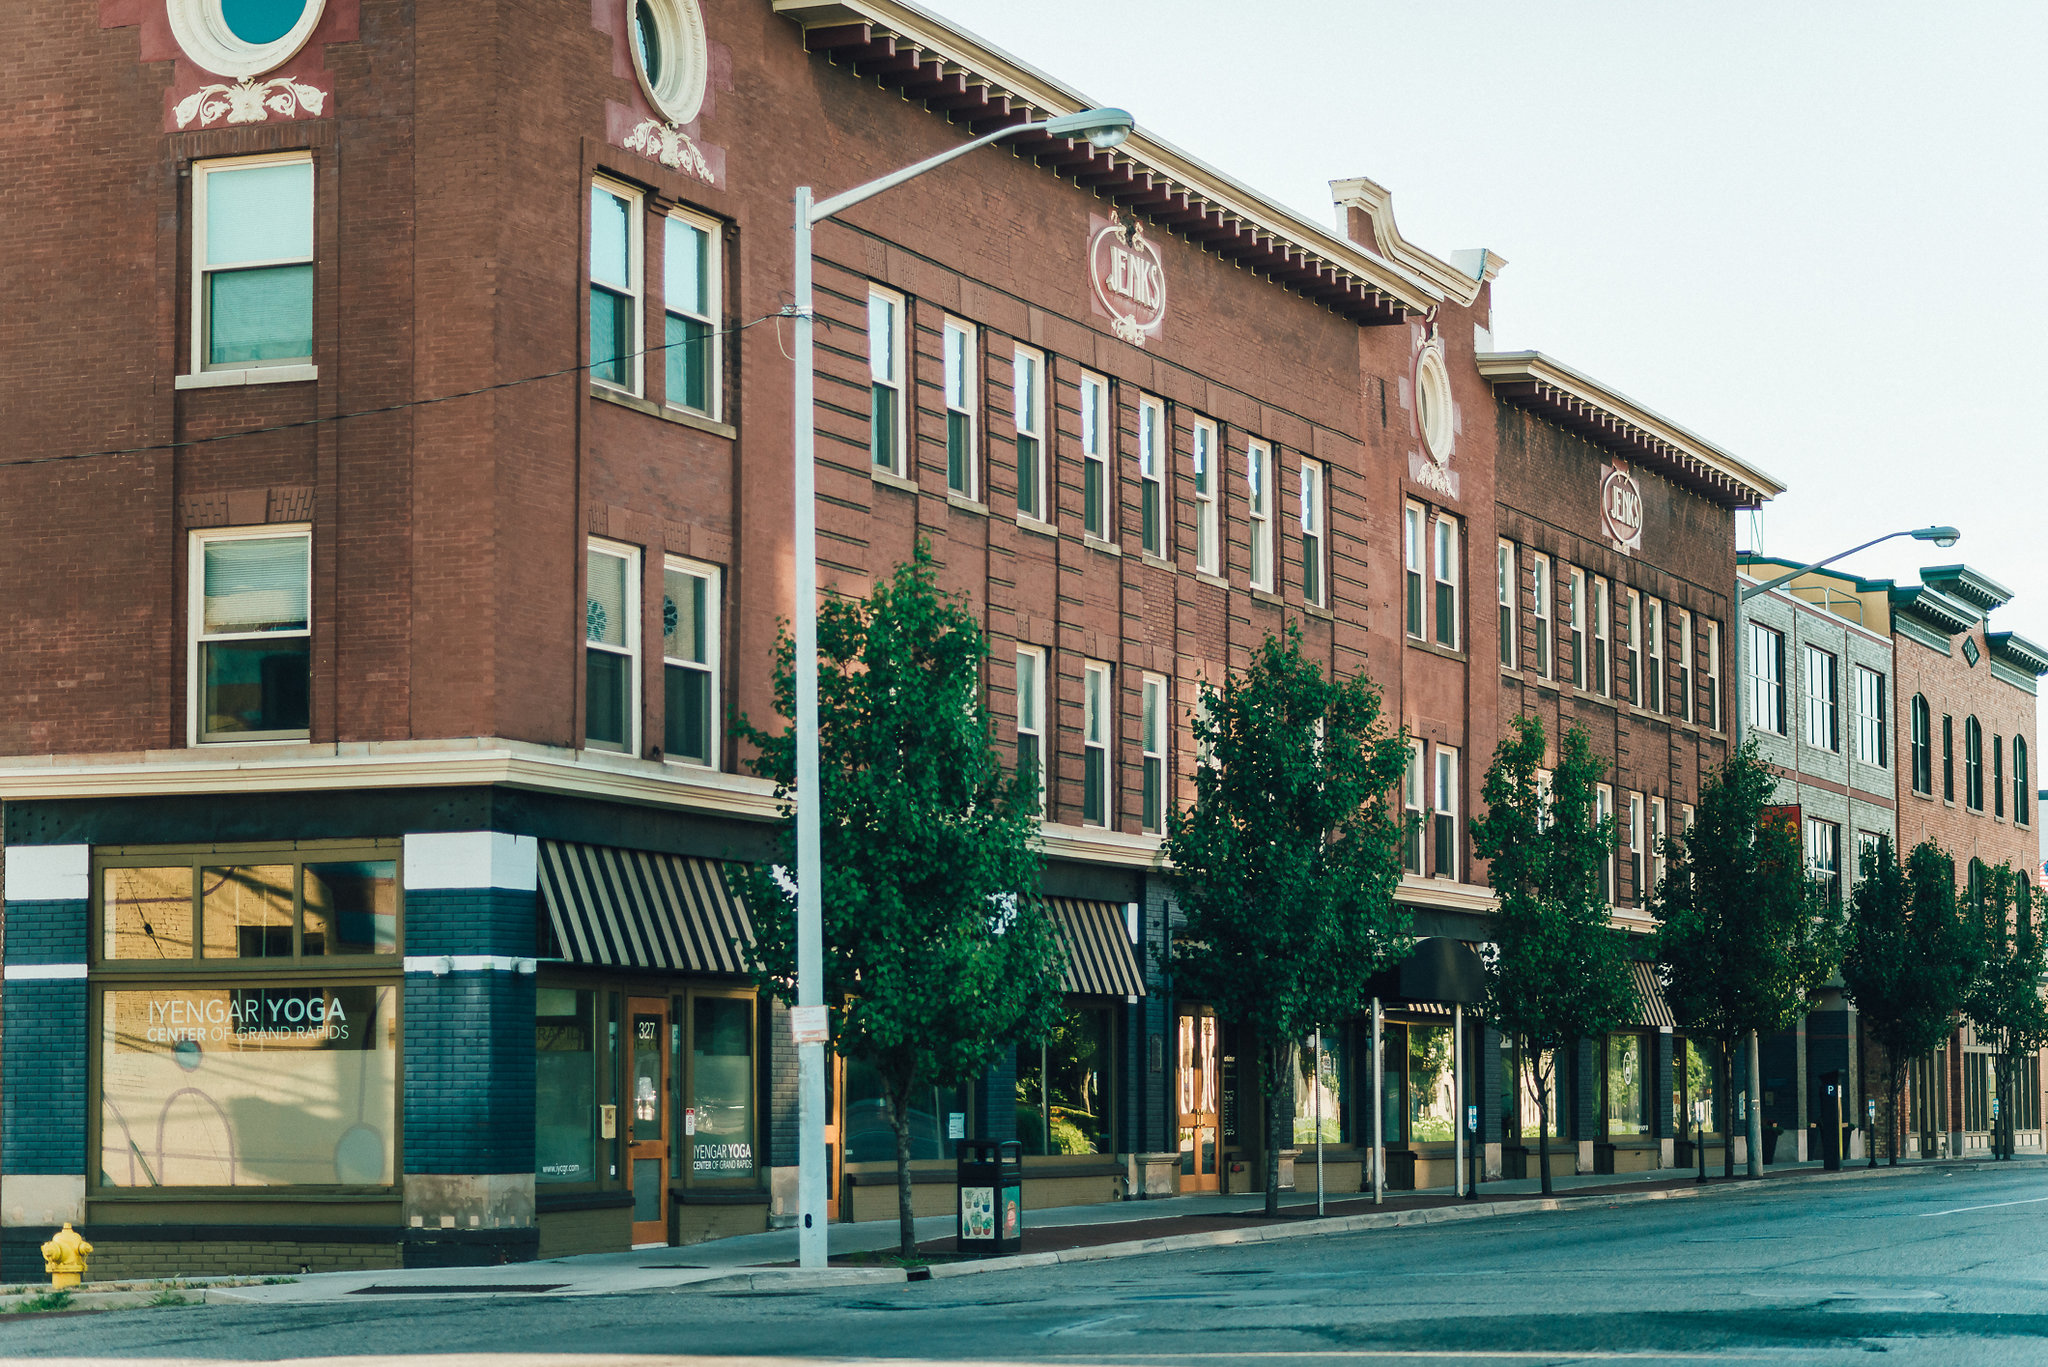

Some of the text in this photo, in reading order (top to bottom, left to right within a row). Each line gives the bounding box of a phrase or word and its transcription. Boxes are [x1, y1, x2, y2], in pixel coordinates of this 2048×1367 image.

[1106, 246, 1160, 309] JENKS
[1610, 485, 1640, 529] JENKS
[149, 997, 346, 1024] IYENGAR YOGA
[147, 1024, 349, 1043] CENTER OF GRAND RAPIDS
[638, 1021, 656, 1040] 327
[1827, 1085, 1835, 1096] P
[693, 1143, 752, 1159] IYENGAR YOGA
[693, 1159, 753, 1170] CENTER OF GRAND RAPIDS
